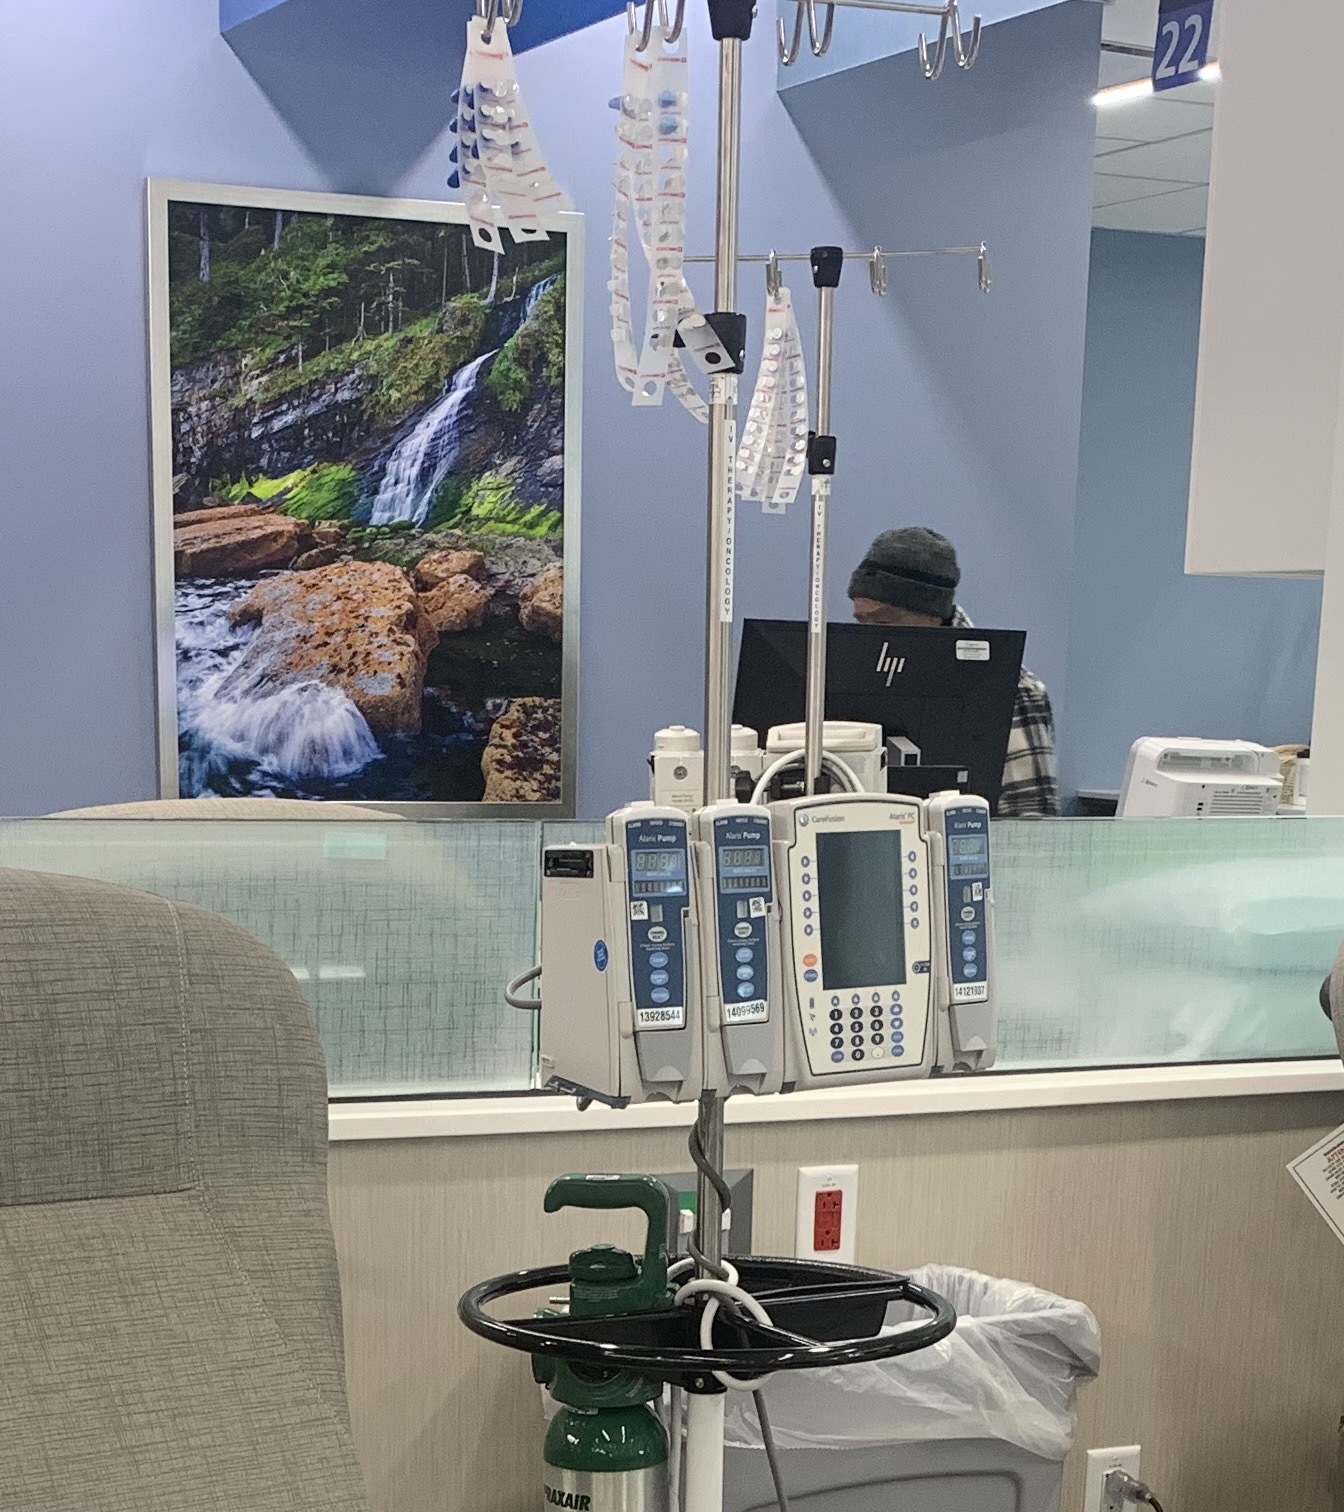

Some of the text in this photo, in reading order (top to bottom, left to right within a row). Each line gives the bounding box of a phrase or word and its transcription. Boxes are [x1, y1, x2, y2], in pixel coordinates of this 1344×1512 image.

[1156, 14, 1203, 80] 22
[876, 641, 905, 687] hp
[640, 1010, 680, 1023] 13928544
[544, 1483, 591, 1511] RAXAIR
